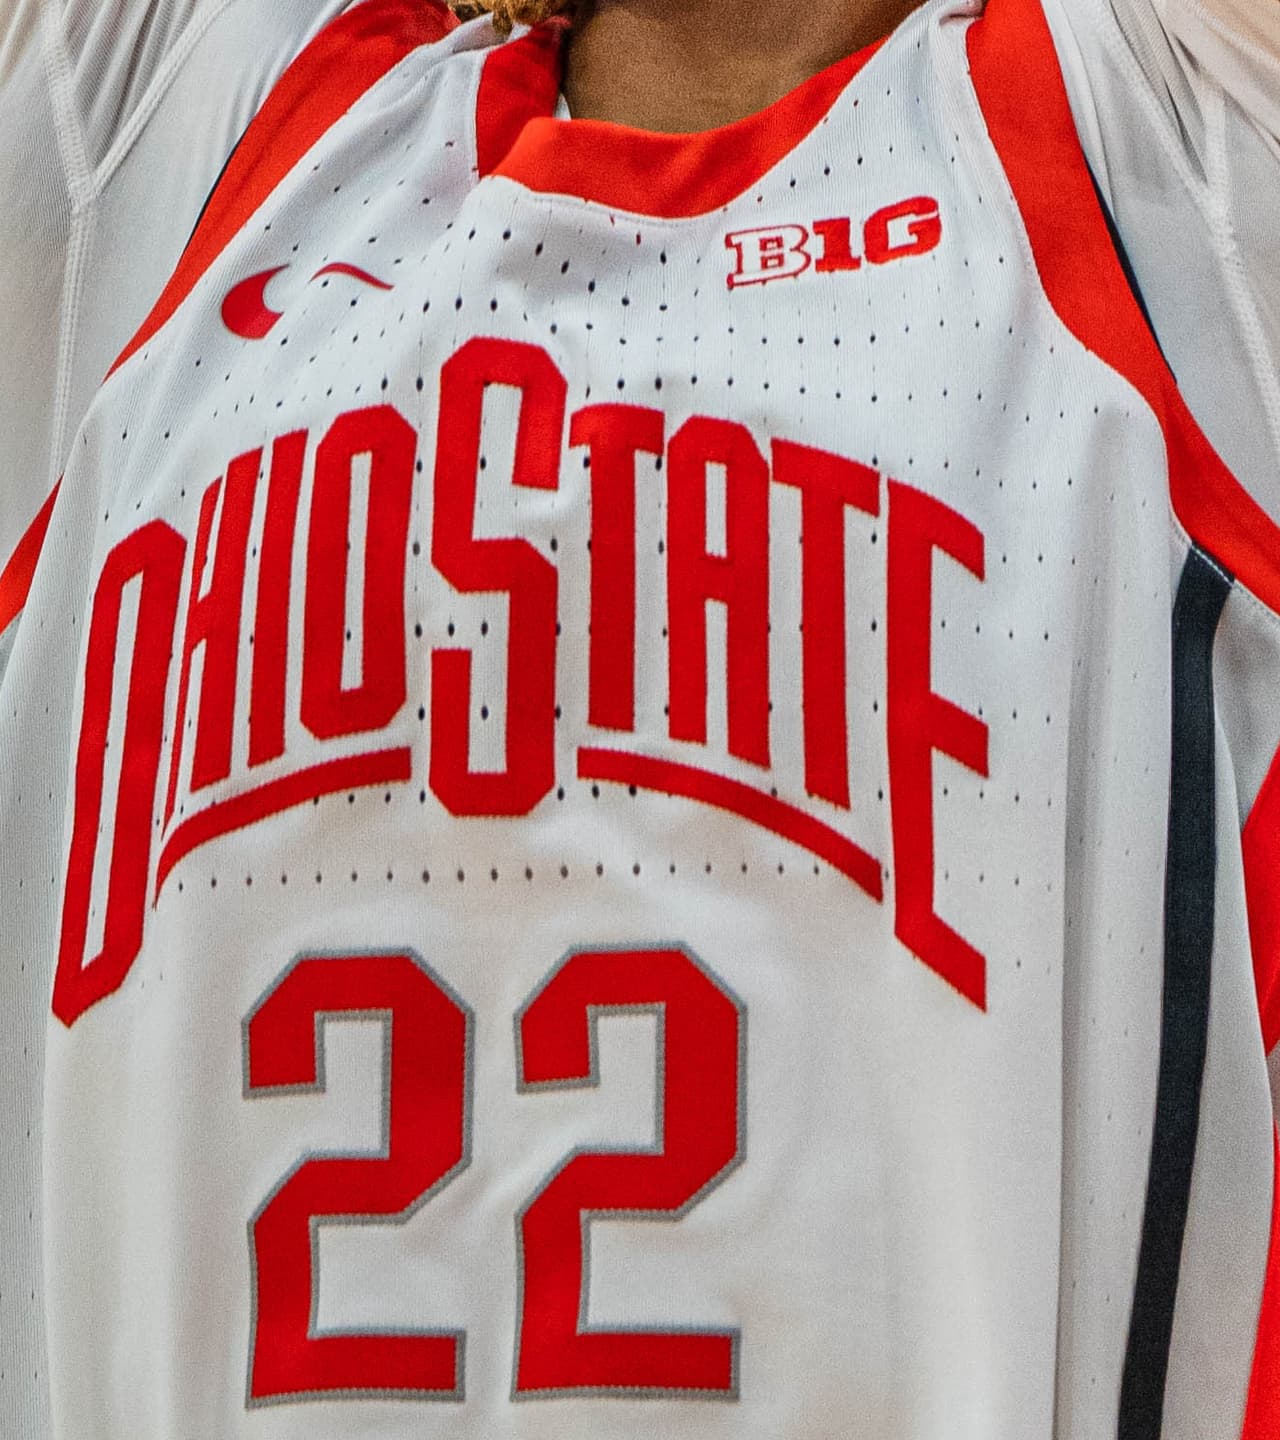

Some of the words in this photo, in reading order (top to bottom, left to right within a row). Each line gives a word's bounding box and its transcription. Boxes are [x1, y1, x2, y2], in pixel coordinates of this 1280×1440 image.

[52, 405, 416, 1026] OHIO
[429, 337, 988, 1010] STATE
[242, 942, 748, 1408] 22
